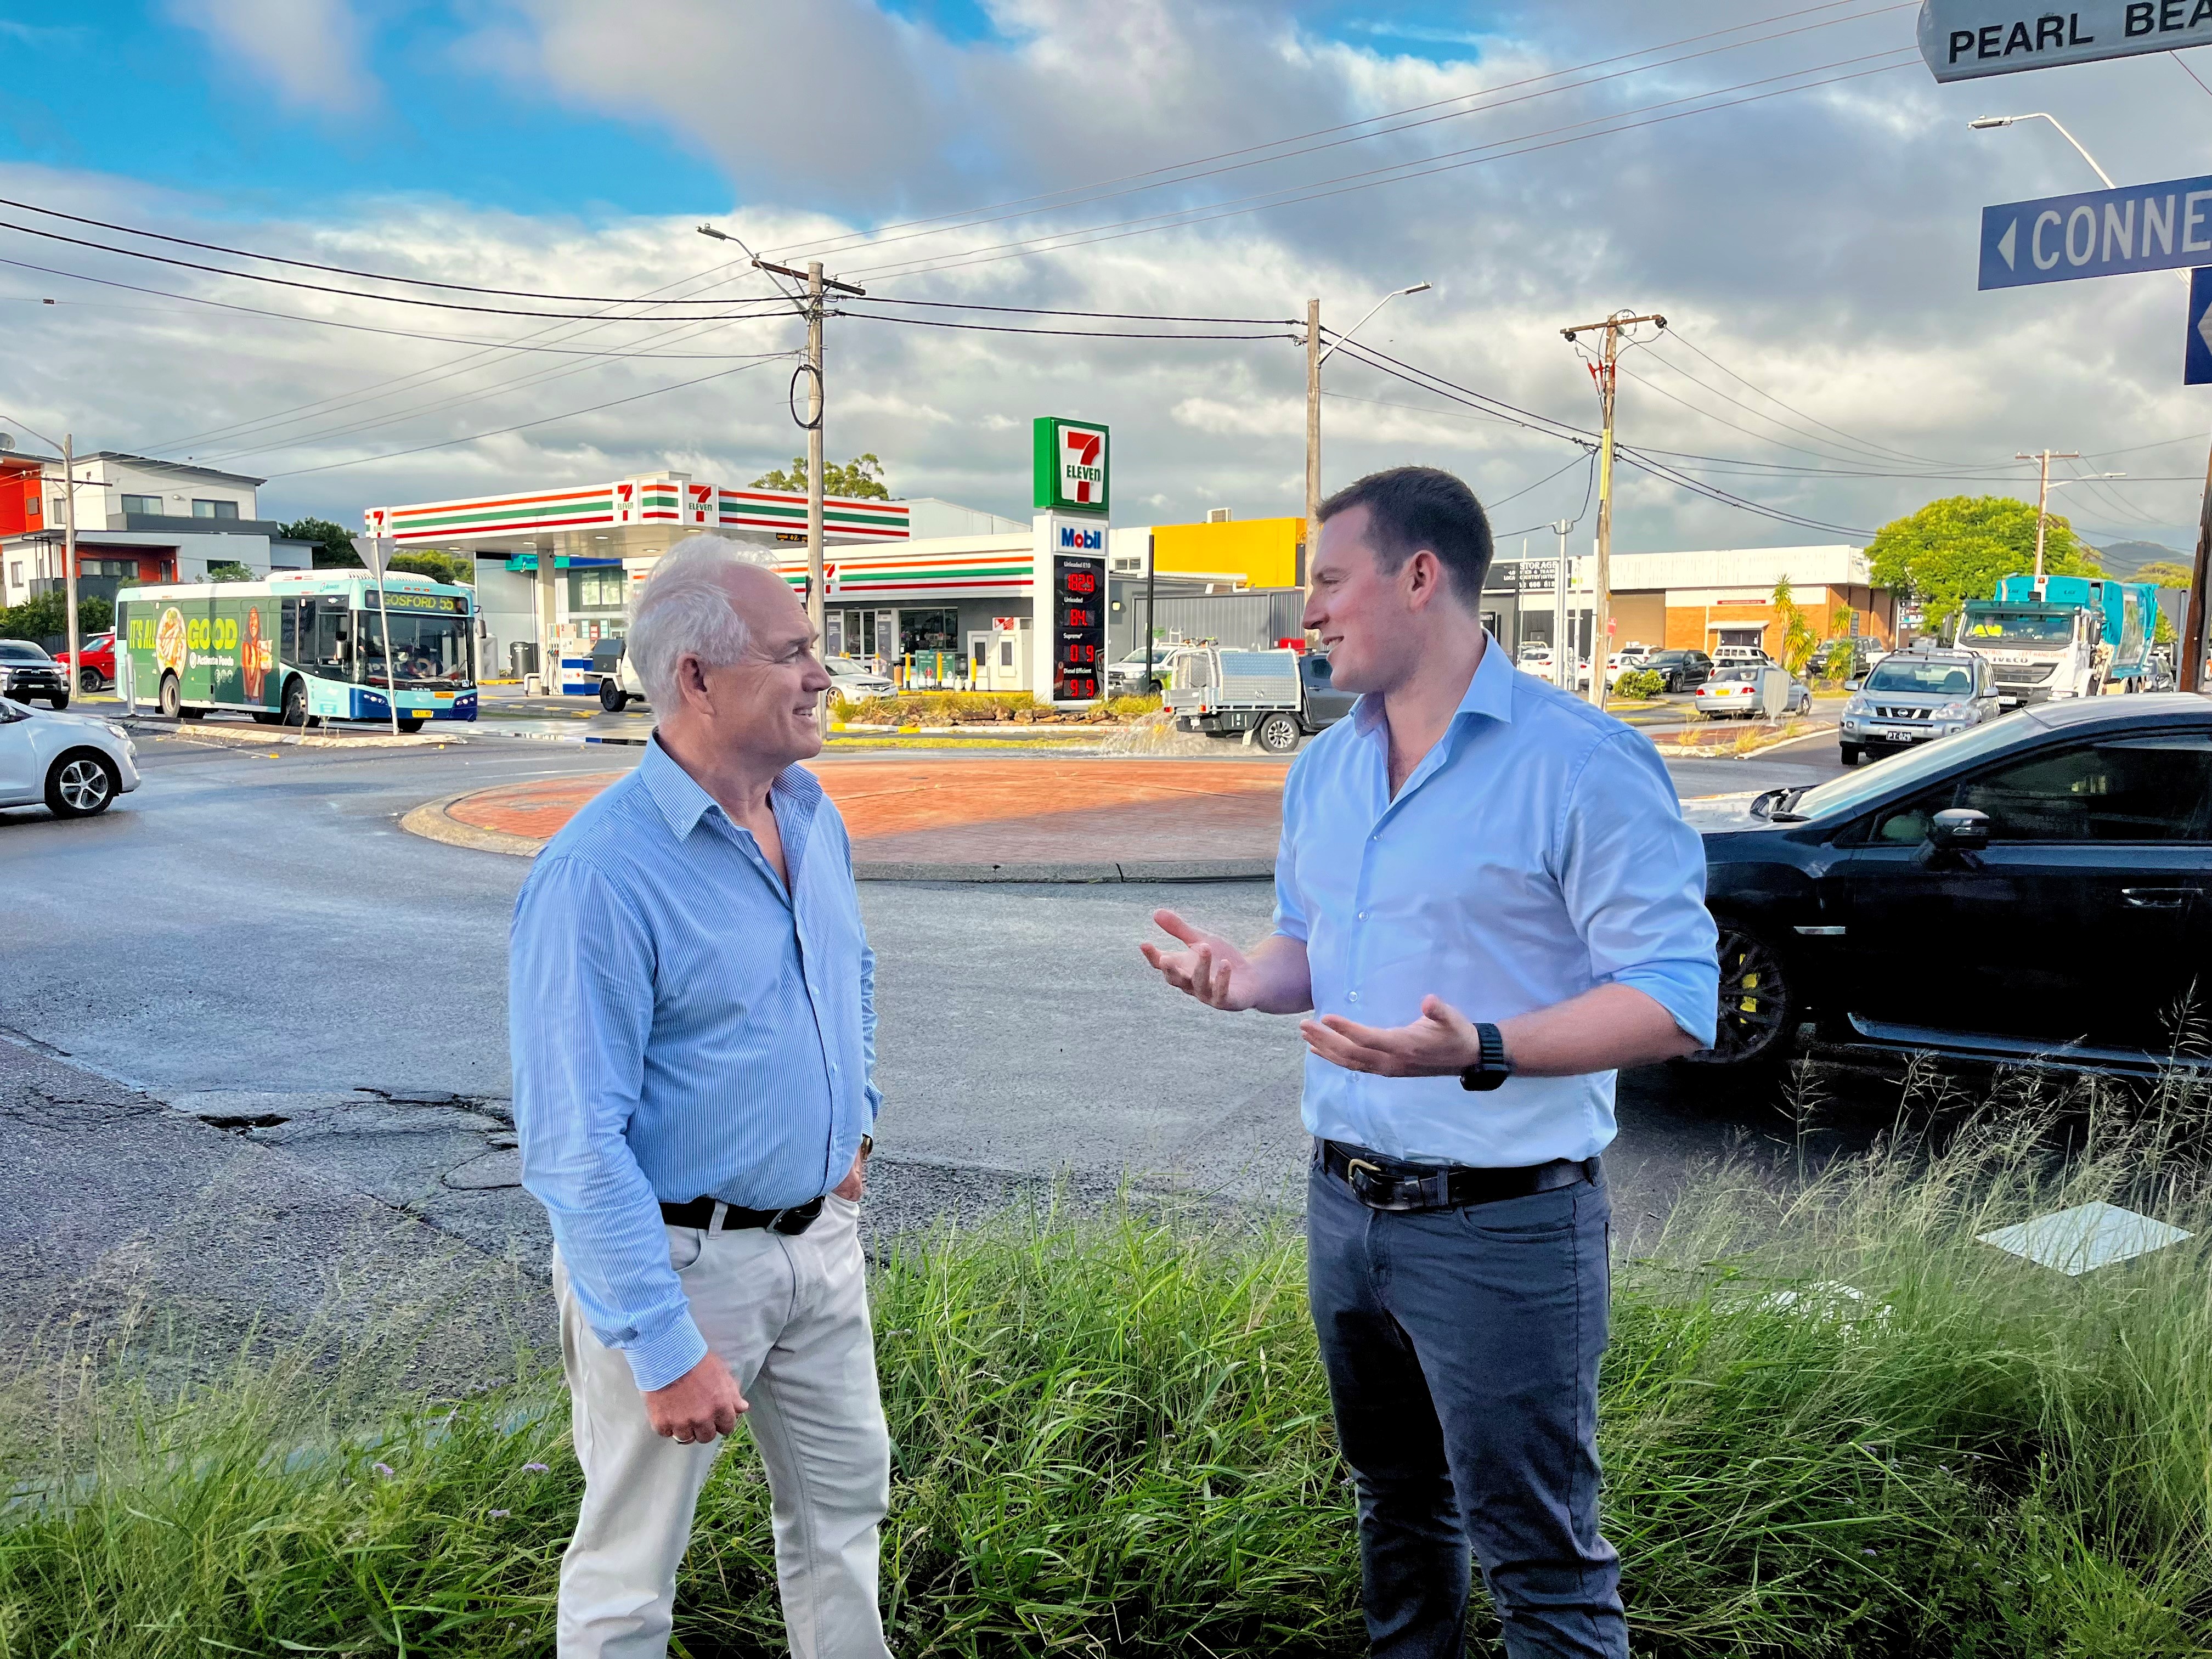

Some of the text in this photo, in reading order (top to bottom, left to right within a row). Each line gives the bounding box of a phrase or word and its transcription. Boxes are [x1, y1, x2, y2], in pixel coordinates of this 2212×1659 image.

[1949, 13, 2094, 64] PEARL
[2032, 190, 2212, 270] CONNE
[1067, 431, 1100, 503] 7
[618, 483, 633, 521] 7
[689, 484, 712, 522] 7
[373, 511, 384, 538] 7
[1062, 527, 1101, 549] Mobil
[385, 594, 454, 611] GOSFORD 55
[129, 619, 142, 649] IT'S
[188, 618, 238, 650] GOOD
